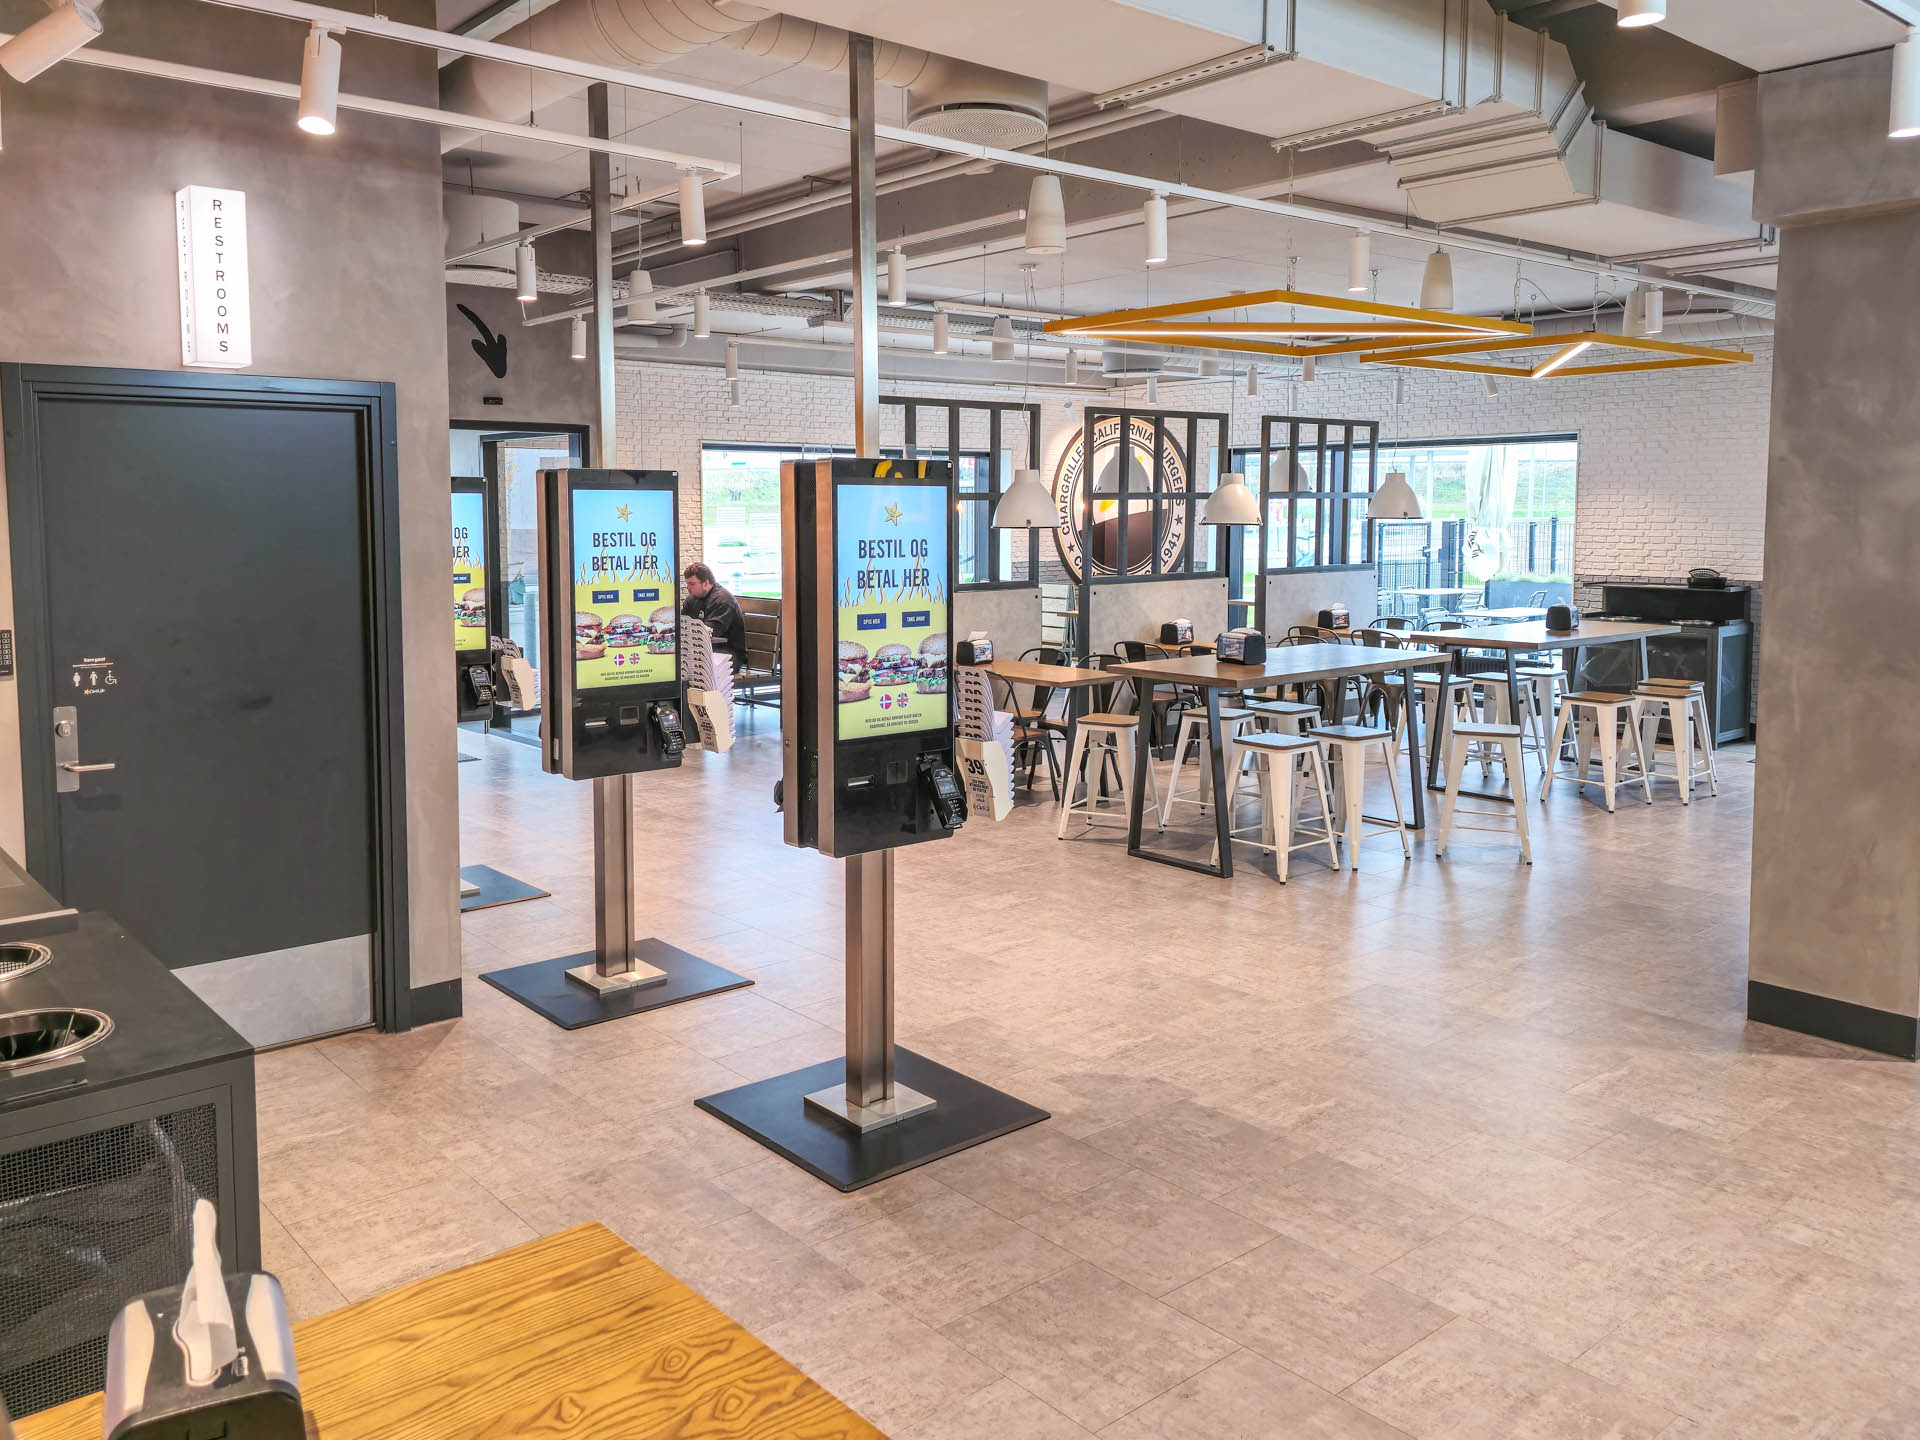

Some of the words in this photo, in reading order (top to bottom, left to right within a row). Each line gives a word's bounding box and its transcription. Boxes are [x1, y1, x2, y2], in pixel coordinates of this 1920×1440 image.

[212, 199, 229, 352] RESTROOMS
[1060, 442, 1084, 536] CHARGRILLE
[1094, 422, 1154, 445] ALIFRNIA
[1162, 447, 1185, 507] URGERS
[454, 527, 468, 539] OG
[592, 532, 636, 548] BESTIL
[640, 531, 657, 547] OG
[858, 539, 906, 559] BESTIL
[910, 538, 929, 558] OG
[1160, 532, 1181, 567] 1941
[591, 555, 630, 571] BETAL
[634, 554, 659, 570] HER
[857, 569, 899, 590] BETAL
[903, 568, 930, 588] HER
[965, 758, 985, 776] 39
